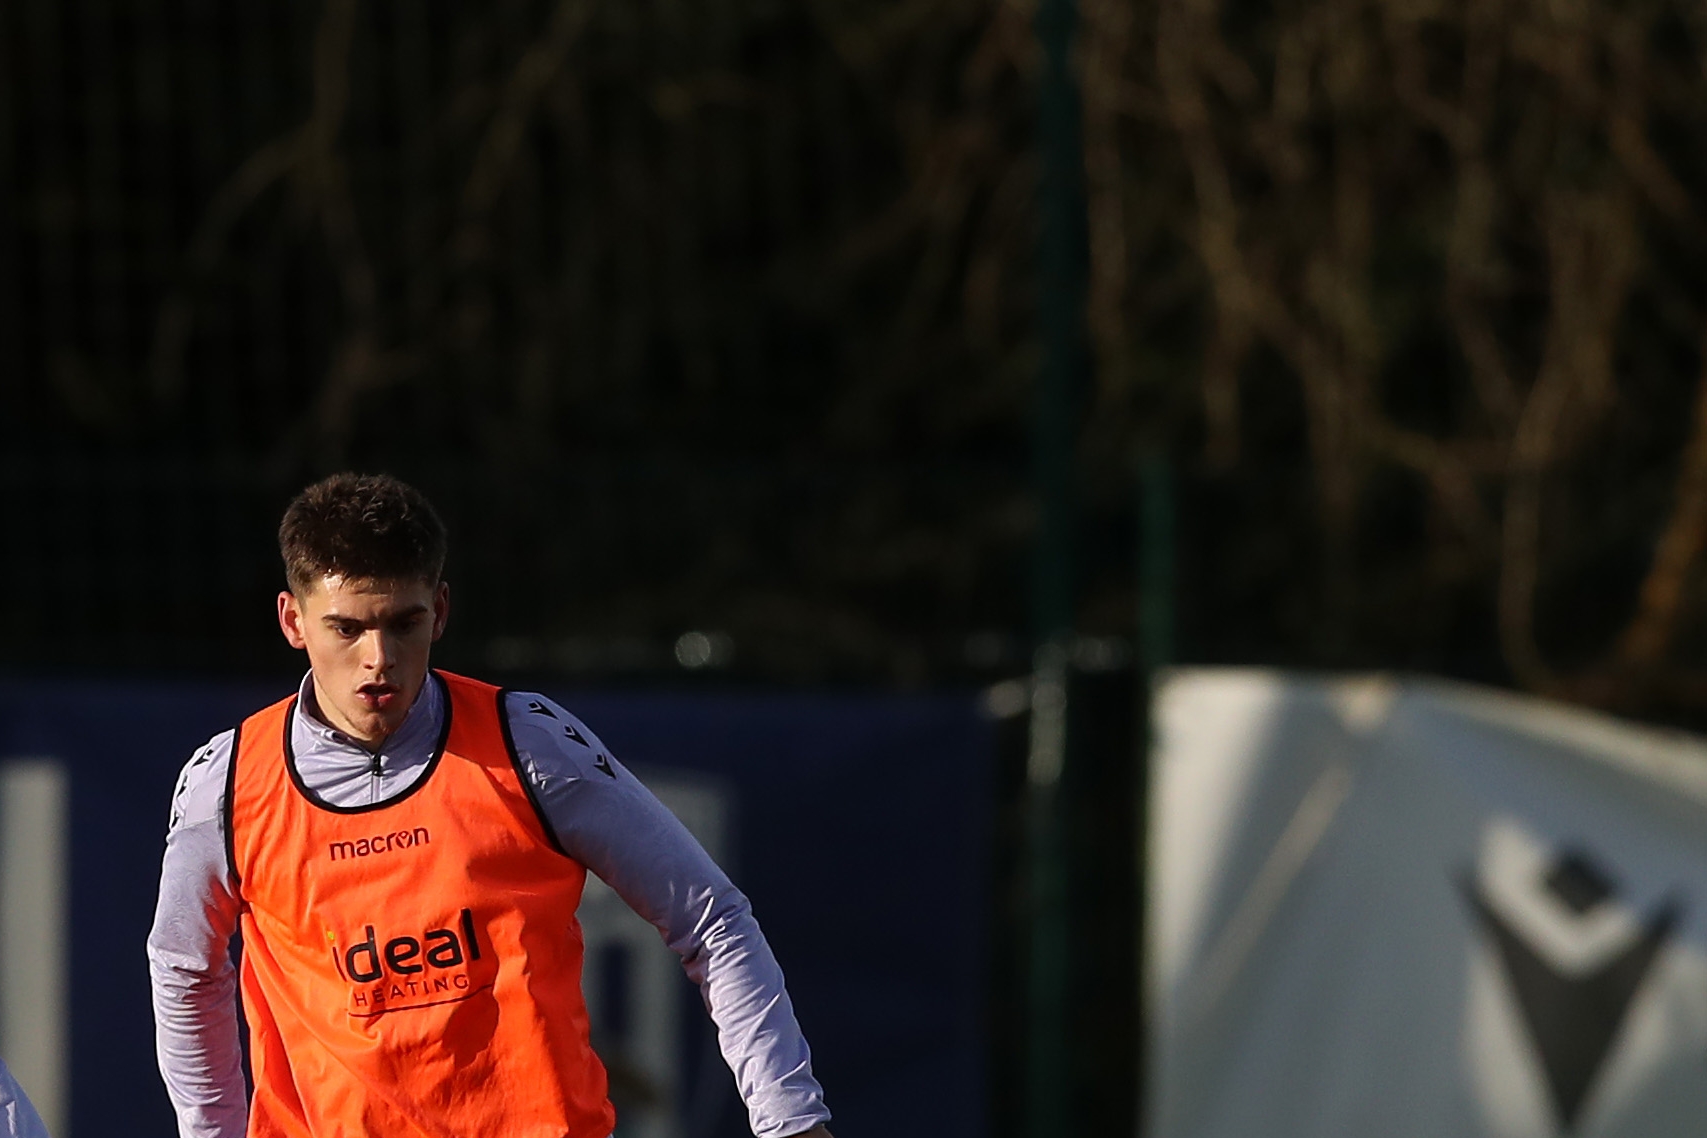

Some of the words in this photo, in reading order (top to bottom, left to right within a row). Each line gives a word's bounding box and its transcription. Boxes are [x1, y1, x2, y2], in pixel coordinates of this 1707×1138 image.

[329, 827, 430, 861] macron
[327, 908, 480, 983] ideal
[354, 974, 469, 1007] HEATING
